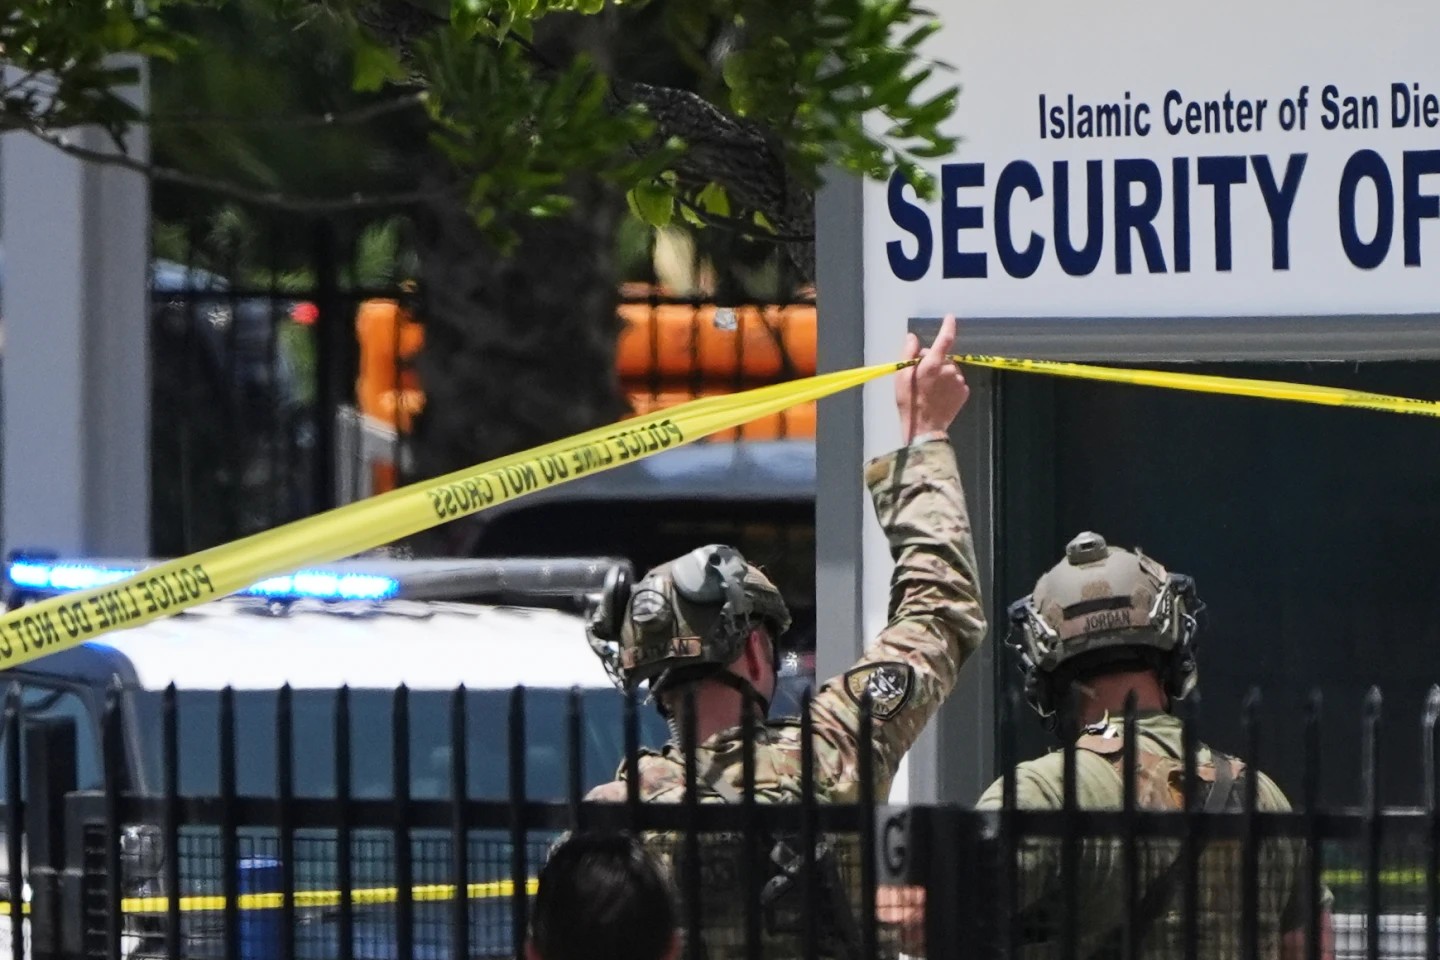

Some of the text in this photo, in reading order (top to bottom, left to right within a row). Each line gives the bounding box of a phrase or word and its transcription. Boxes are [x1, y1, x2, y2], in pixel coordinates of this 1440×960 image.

[1038, 91, 1151, 140] Islamic
[1163, 89, 1268, 136] Center
[1278, 85, 1309, 132] of
[1320, 84, 1379, 131] San
[885, 152, 1308, 282] SECURITY
[1085, 611, 1130, 632] JORDAN
